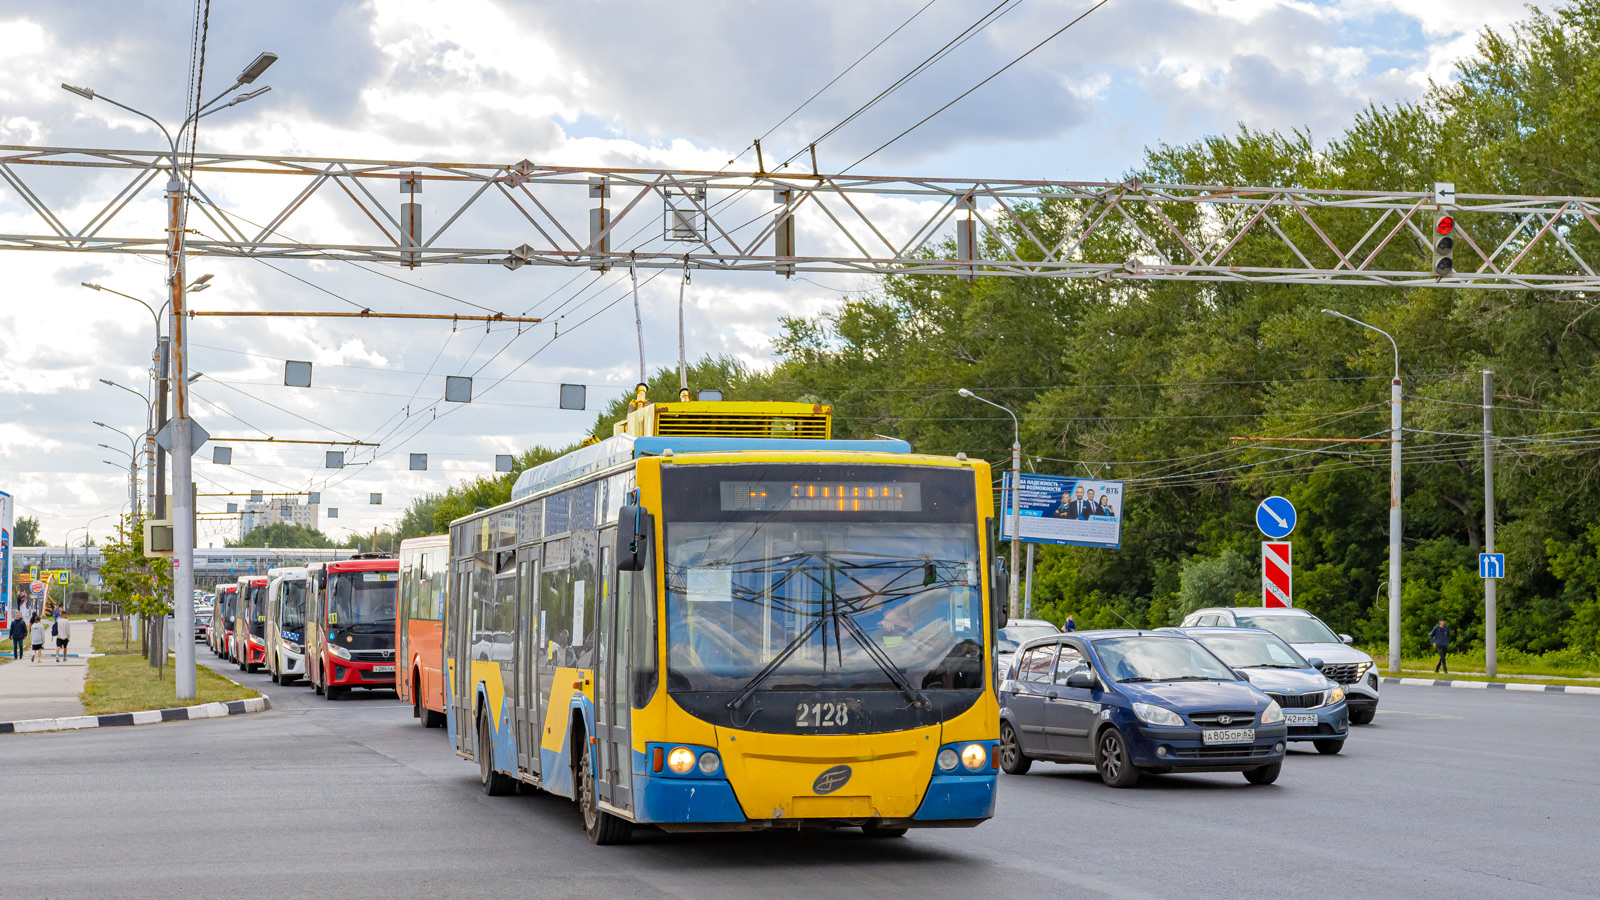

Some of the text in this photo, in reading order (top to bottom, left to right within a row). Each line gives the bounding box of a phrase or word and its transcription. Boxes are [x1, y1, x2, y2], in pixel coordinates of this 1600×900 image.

[796, 702, 849, 727] 2128
[1284, 714, 1307, 723] 742РР
[1243, 729, 1252, 737] 62
